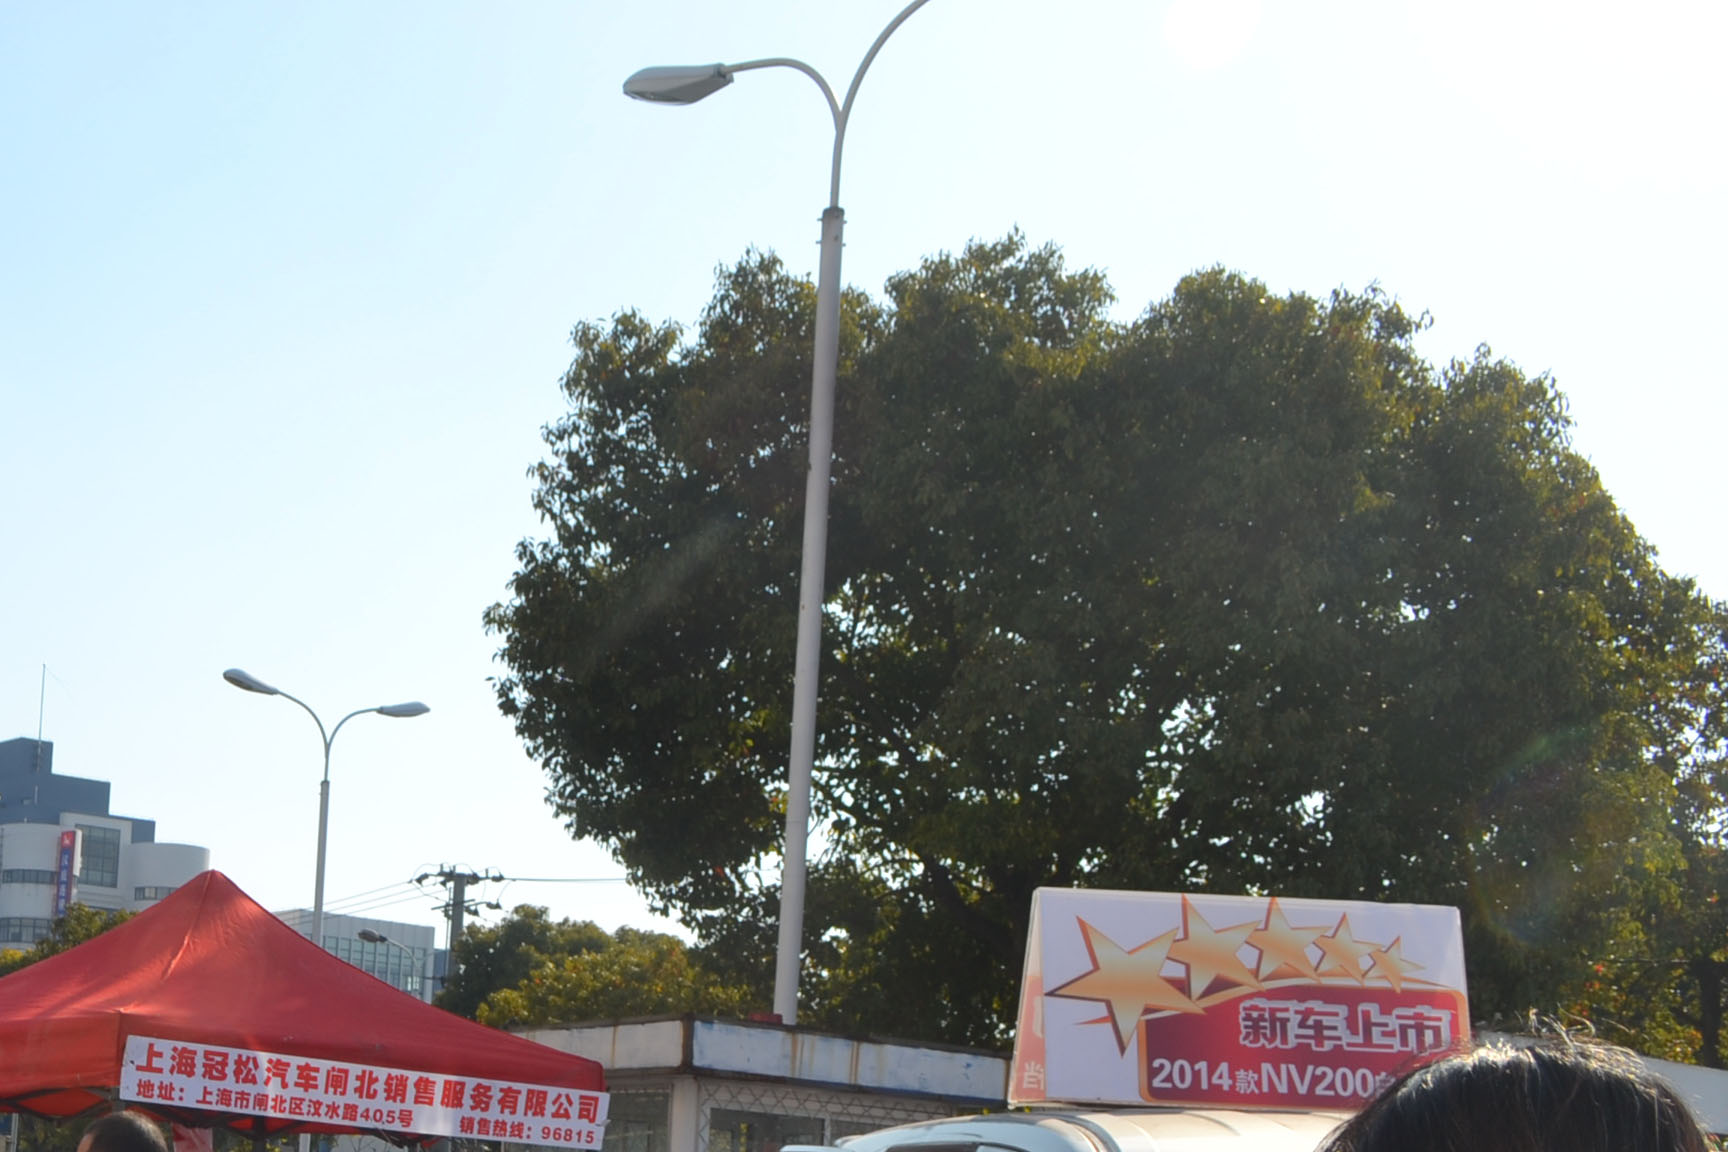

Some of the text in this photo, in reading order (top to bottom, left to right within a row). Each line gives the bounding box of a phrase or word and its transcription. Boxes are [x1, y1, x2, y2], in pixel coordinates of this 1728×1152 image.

[1239, 997, 1451, 1055] 新车上市
[136, 1043, 599, 1124] 上海冠松汽车闸北销售服务有限公司
